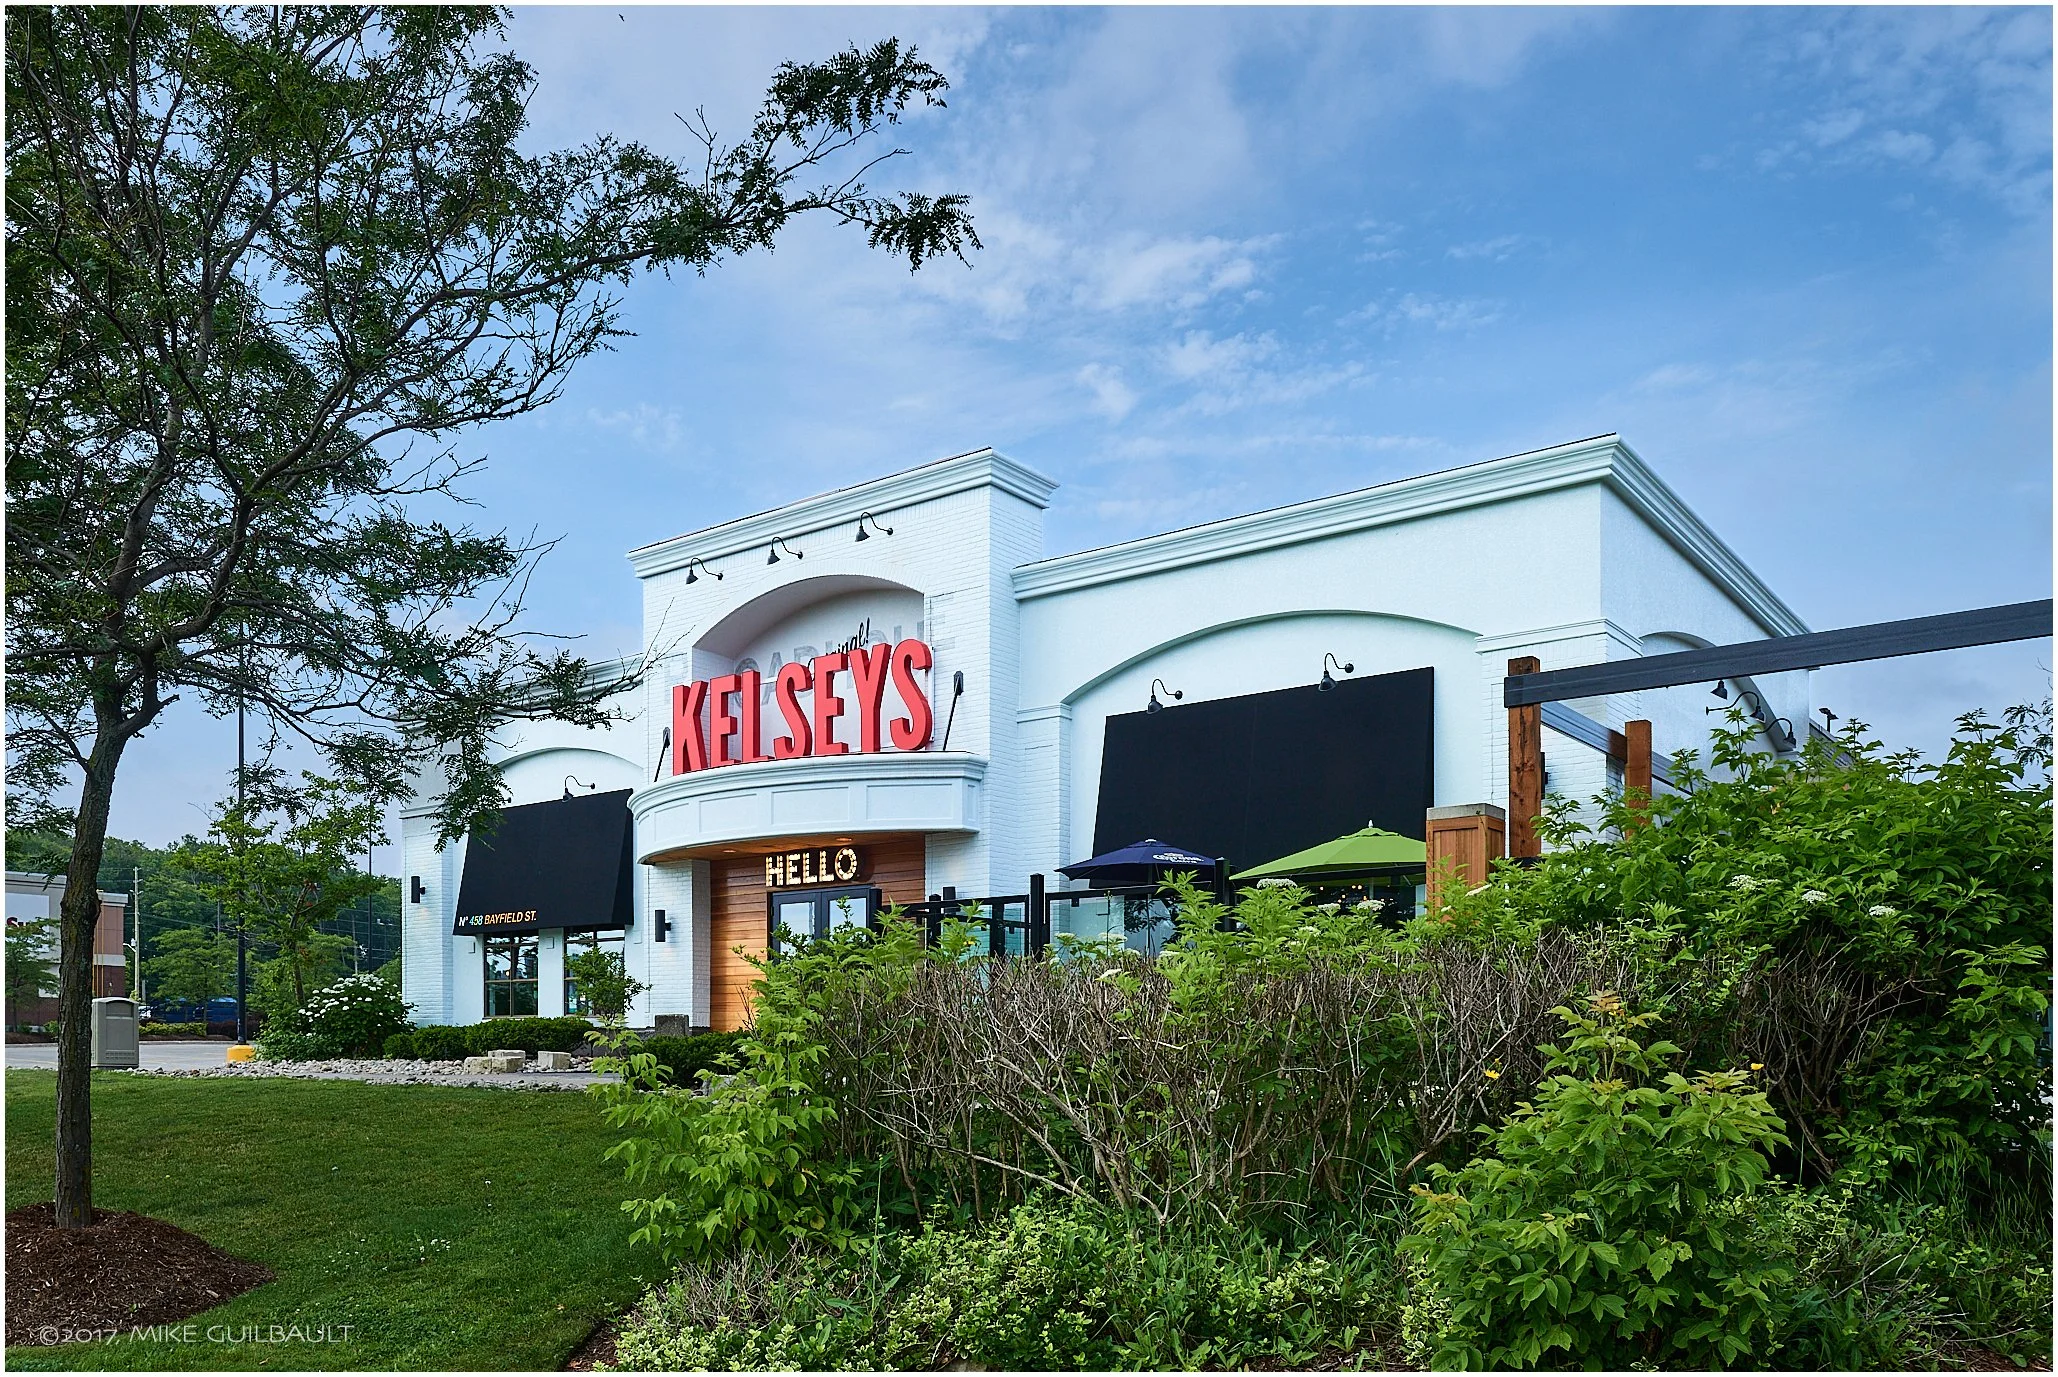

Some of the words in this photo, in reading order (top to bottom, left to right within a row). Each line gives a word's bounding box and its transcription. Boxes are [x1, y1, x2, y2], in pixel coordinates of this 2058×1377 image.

[672, 638, 933, 776] KELSEYS
[766, 847, 858, 887] HELLO
[469, 914, 483, 926] 458
[484, 911, 523, 925] BAYFIELD
[524, 910, 537, 922] ST.
